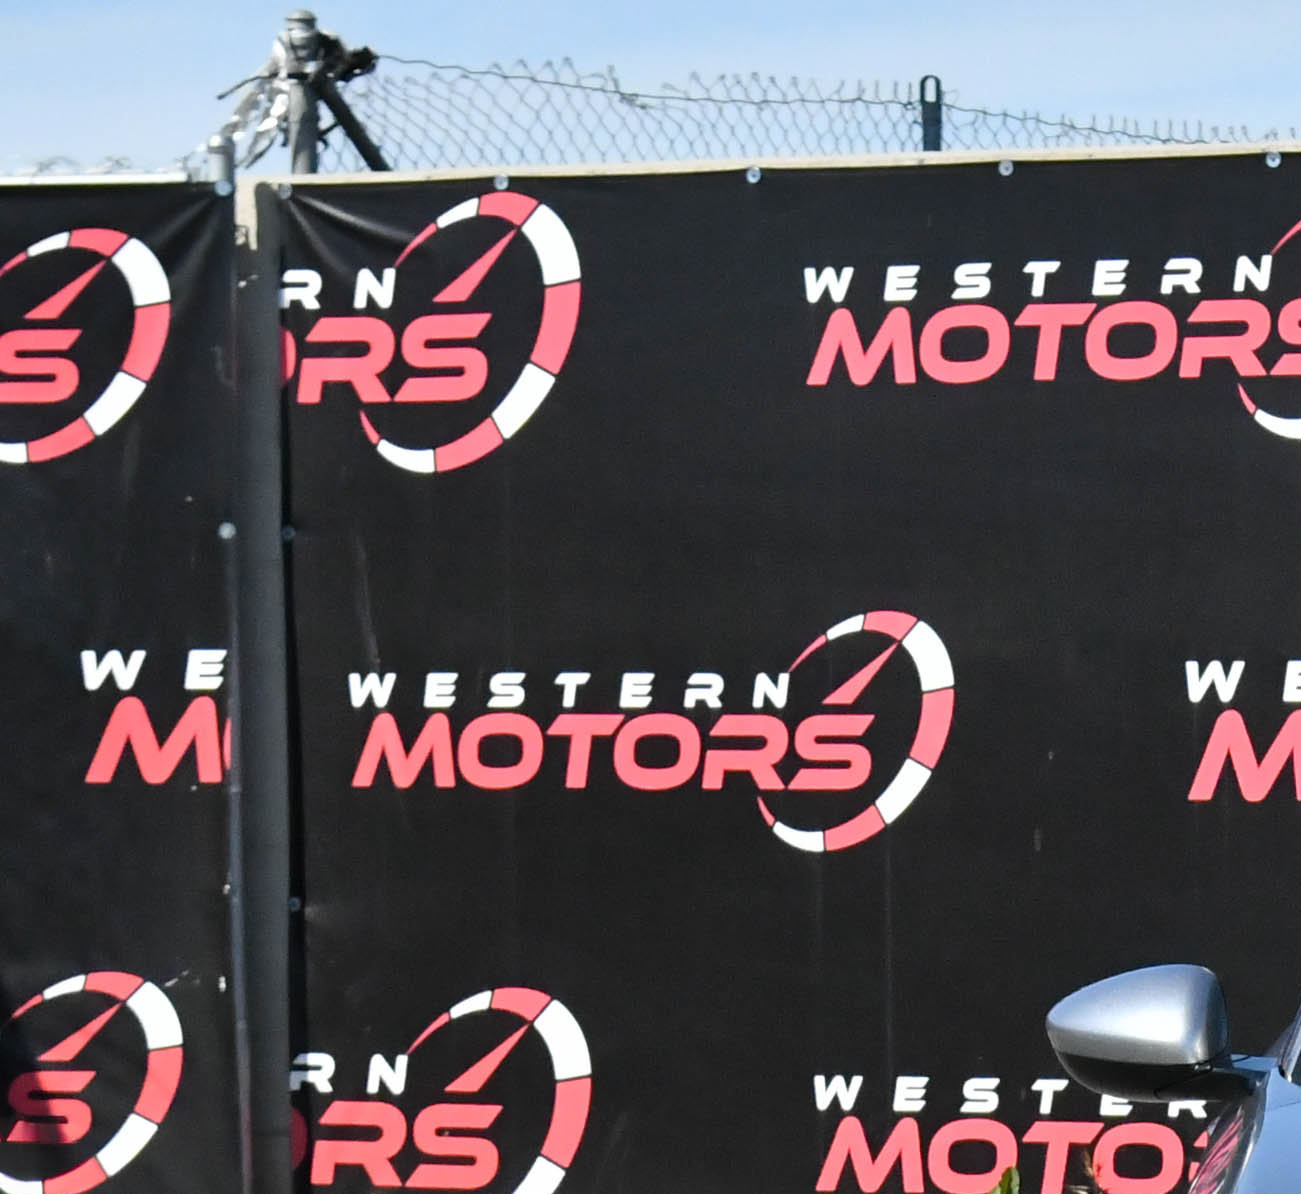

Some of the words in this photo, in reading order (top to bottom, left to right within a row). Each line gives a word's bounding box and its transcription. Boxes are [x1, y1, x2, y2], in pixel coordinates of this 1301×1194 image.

[804, 255, 1272, 303] WESTERN
[282, 313, 492, 404] RS
[349, 672, 789, 708] WESTERN
[352, 712, 875, 790] MOTORS
